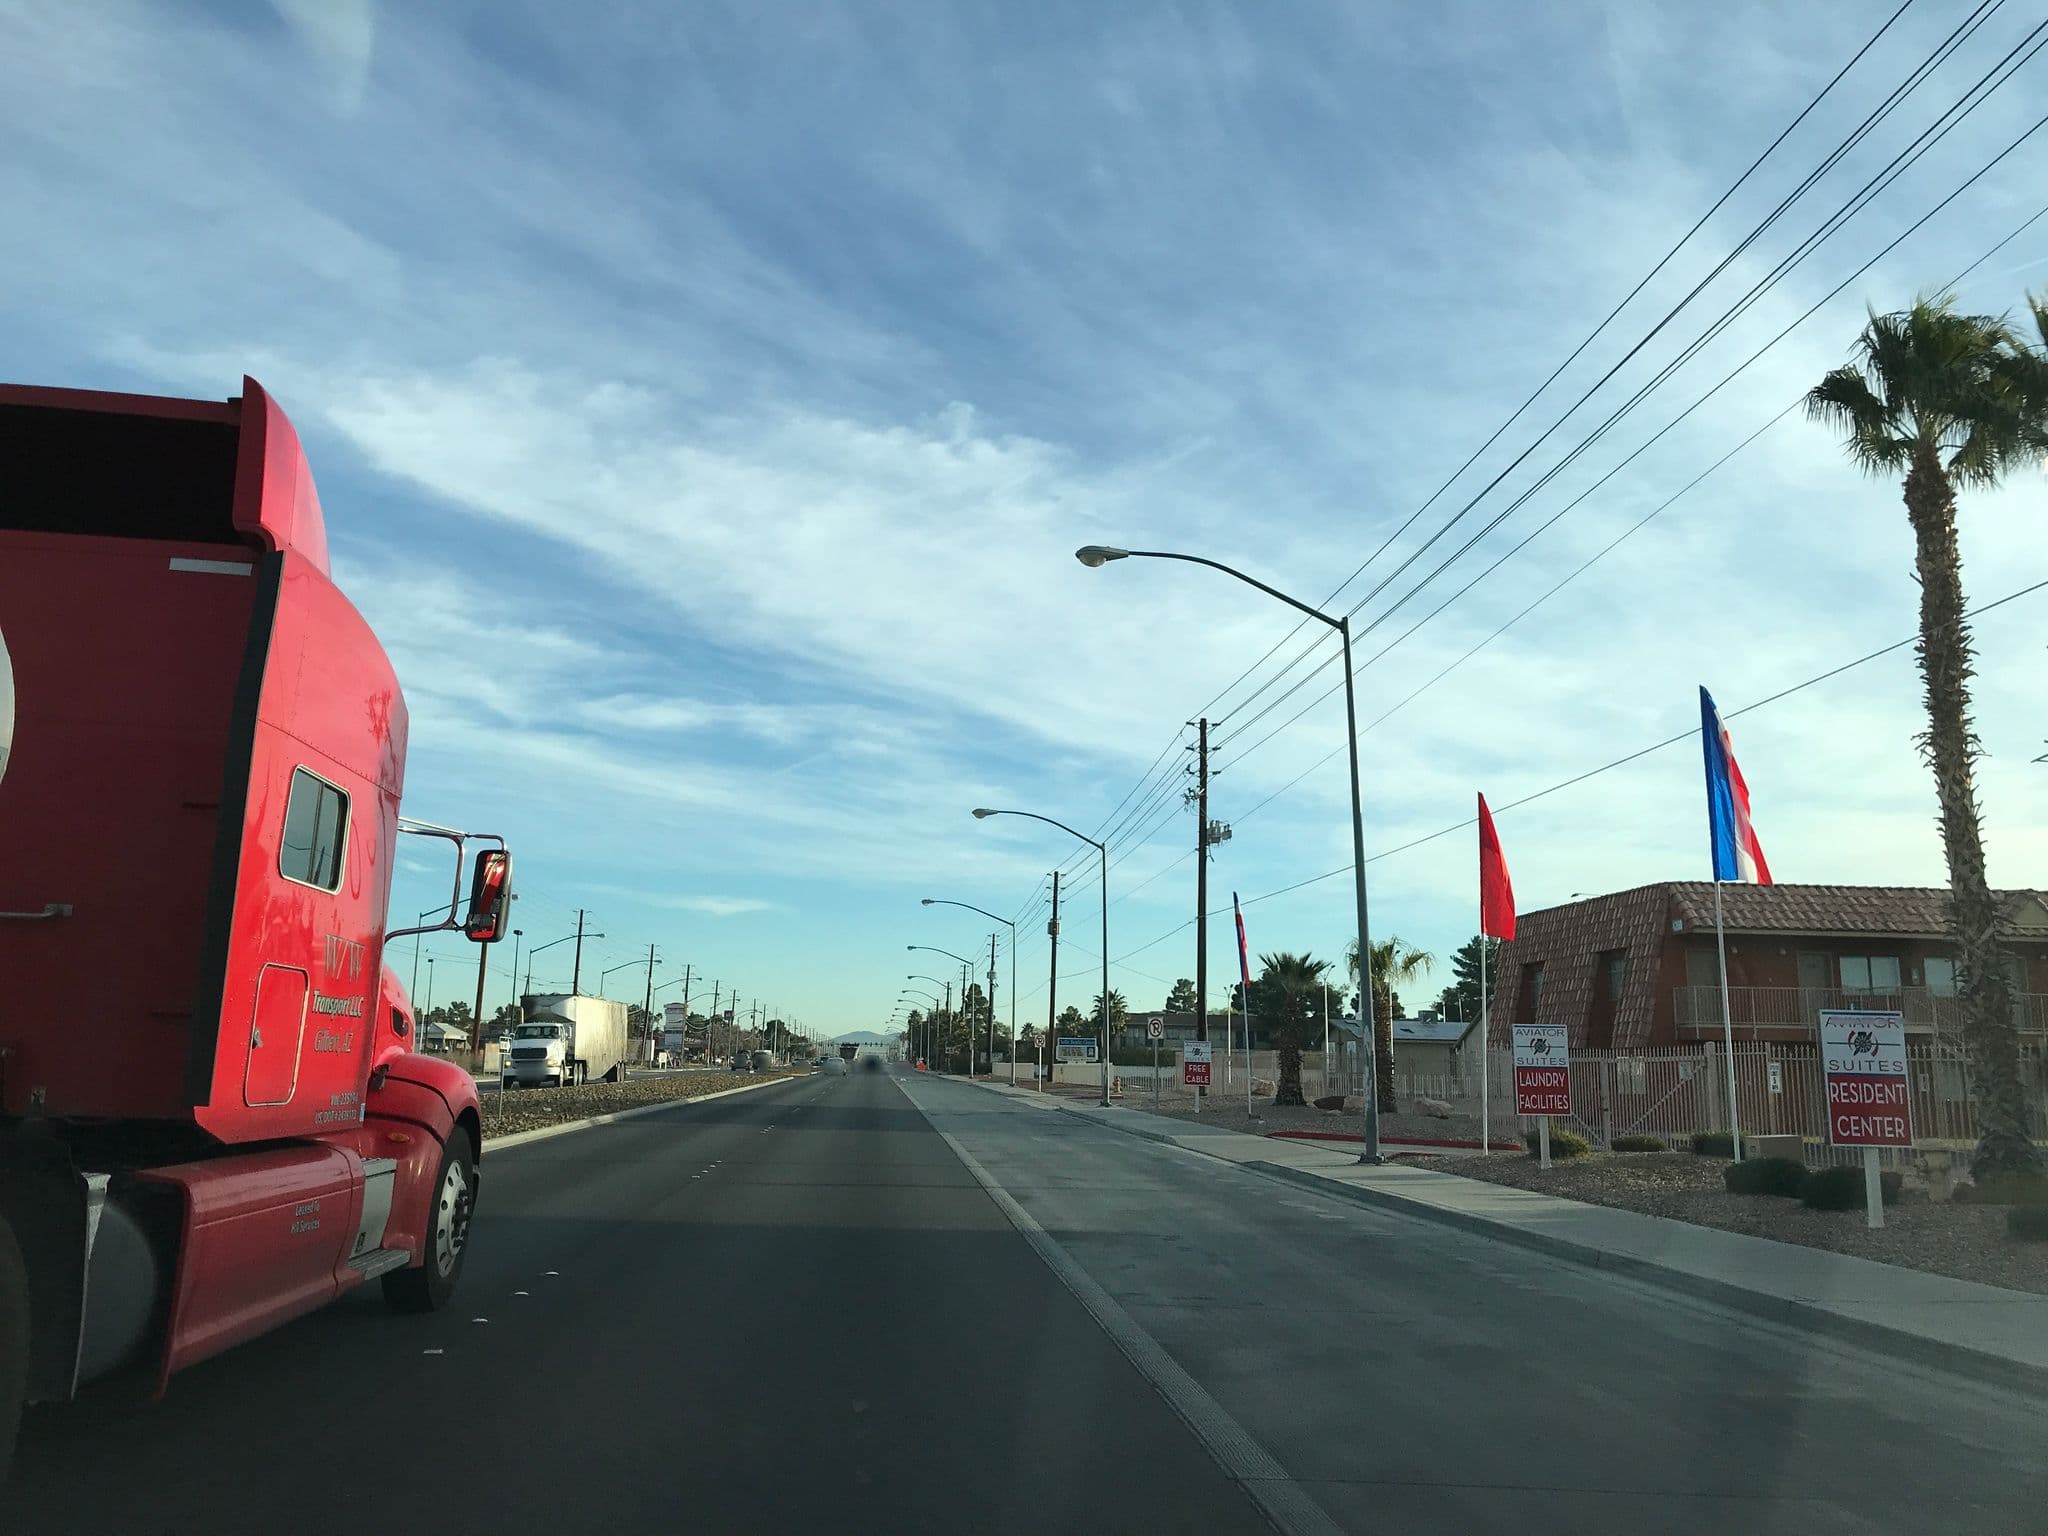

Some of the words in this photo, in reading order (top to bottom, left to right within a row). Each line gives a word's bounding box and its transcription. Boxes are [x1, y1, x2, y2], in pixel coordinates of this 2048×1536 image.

[312, 988, 350, 1019] Transport
[349, 996, 364, 1017] LLC
[1825, 1016, 1900, 1029] AVIATOR
[1515, 1028, 1566, 1038] AVIATOR
[343, 1031, 354, 1053] AZ
[1188, 1064, 1207, 1073] FREE
[1516, 1057, 1567, 1066] SUITES
[1829, 1059, 1904, 1072] SUITES
[1185, 1074, 1209, 1084] CABLE
[1519, 1071, 1566, 1088] LAUNDRY
[1829, 1082, 1905, 1105] RESIDENT
[1519, 1094, 1569, 1110] FACILITIES
[1837, 1115, 1905, 1138] CENTER
